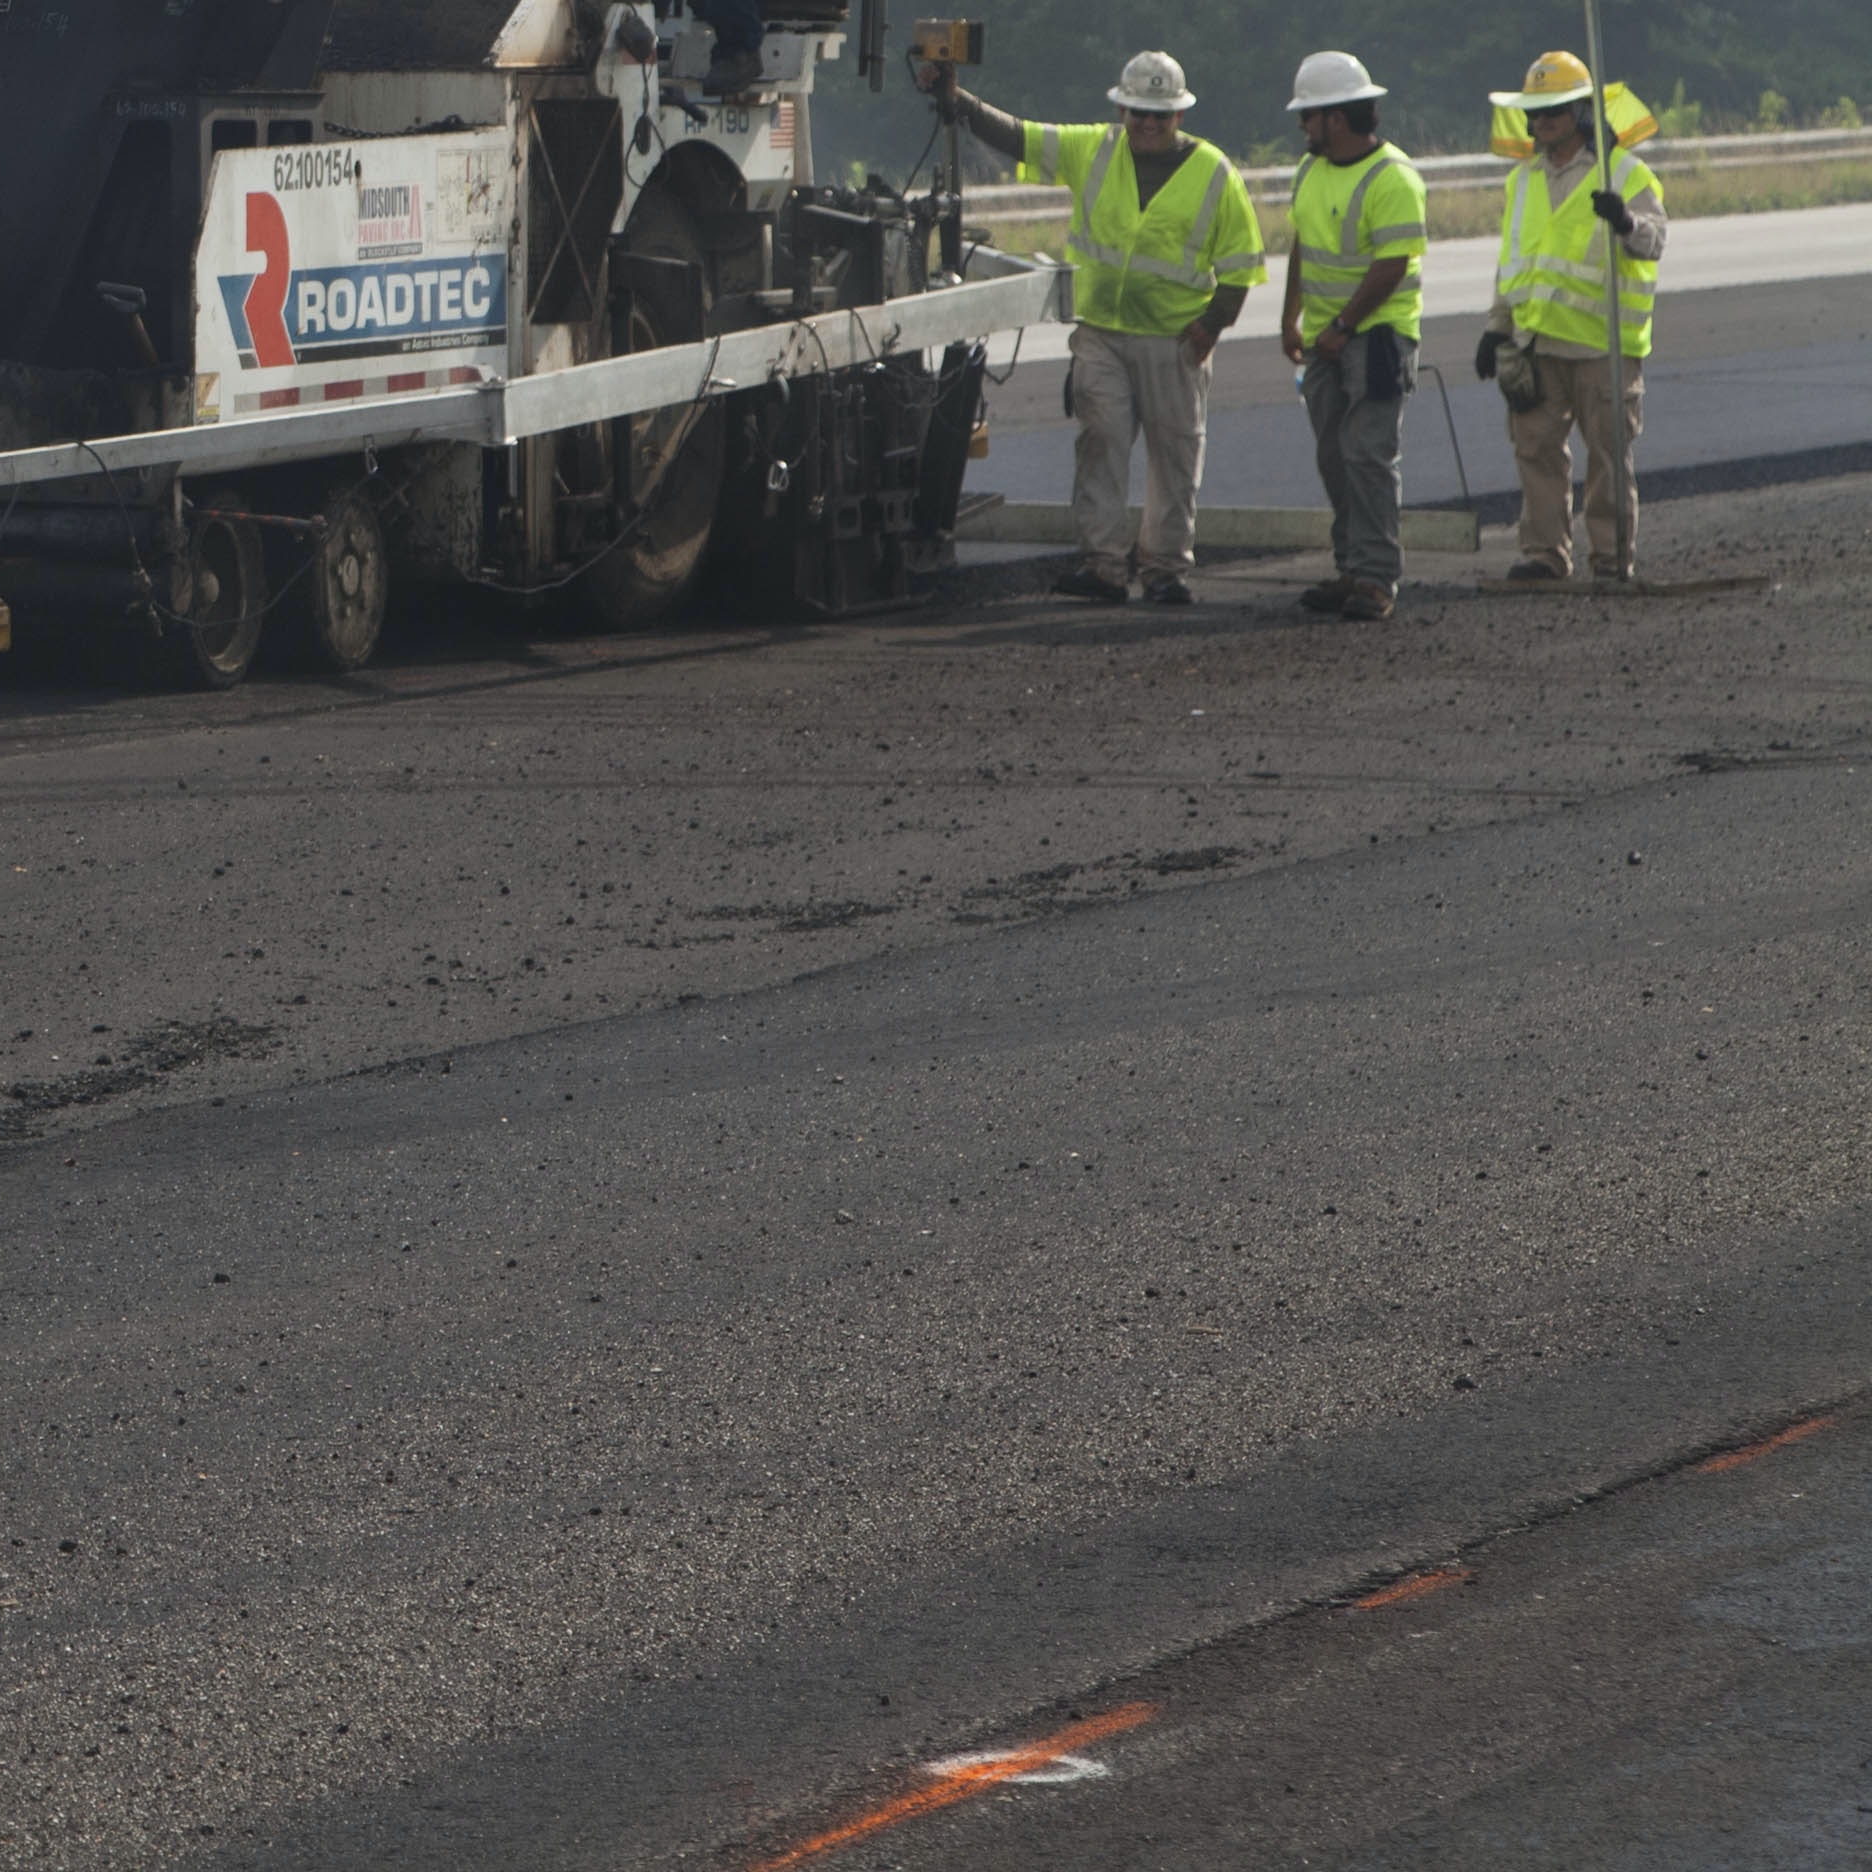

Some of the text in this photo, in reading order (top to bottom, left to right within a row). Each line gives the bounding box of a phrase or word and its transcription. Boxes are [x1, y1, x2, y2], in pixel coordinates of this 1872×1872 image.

[274, 148, 354, 191] 62.100154
[358, 185, 410, 220] MIDSOUTH
[358, 221, 389, 244] PAVING
[297, 266, 491, 335] ROADTEC
[462, 332, 489, 347] Company
